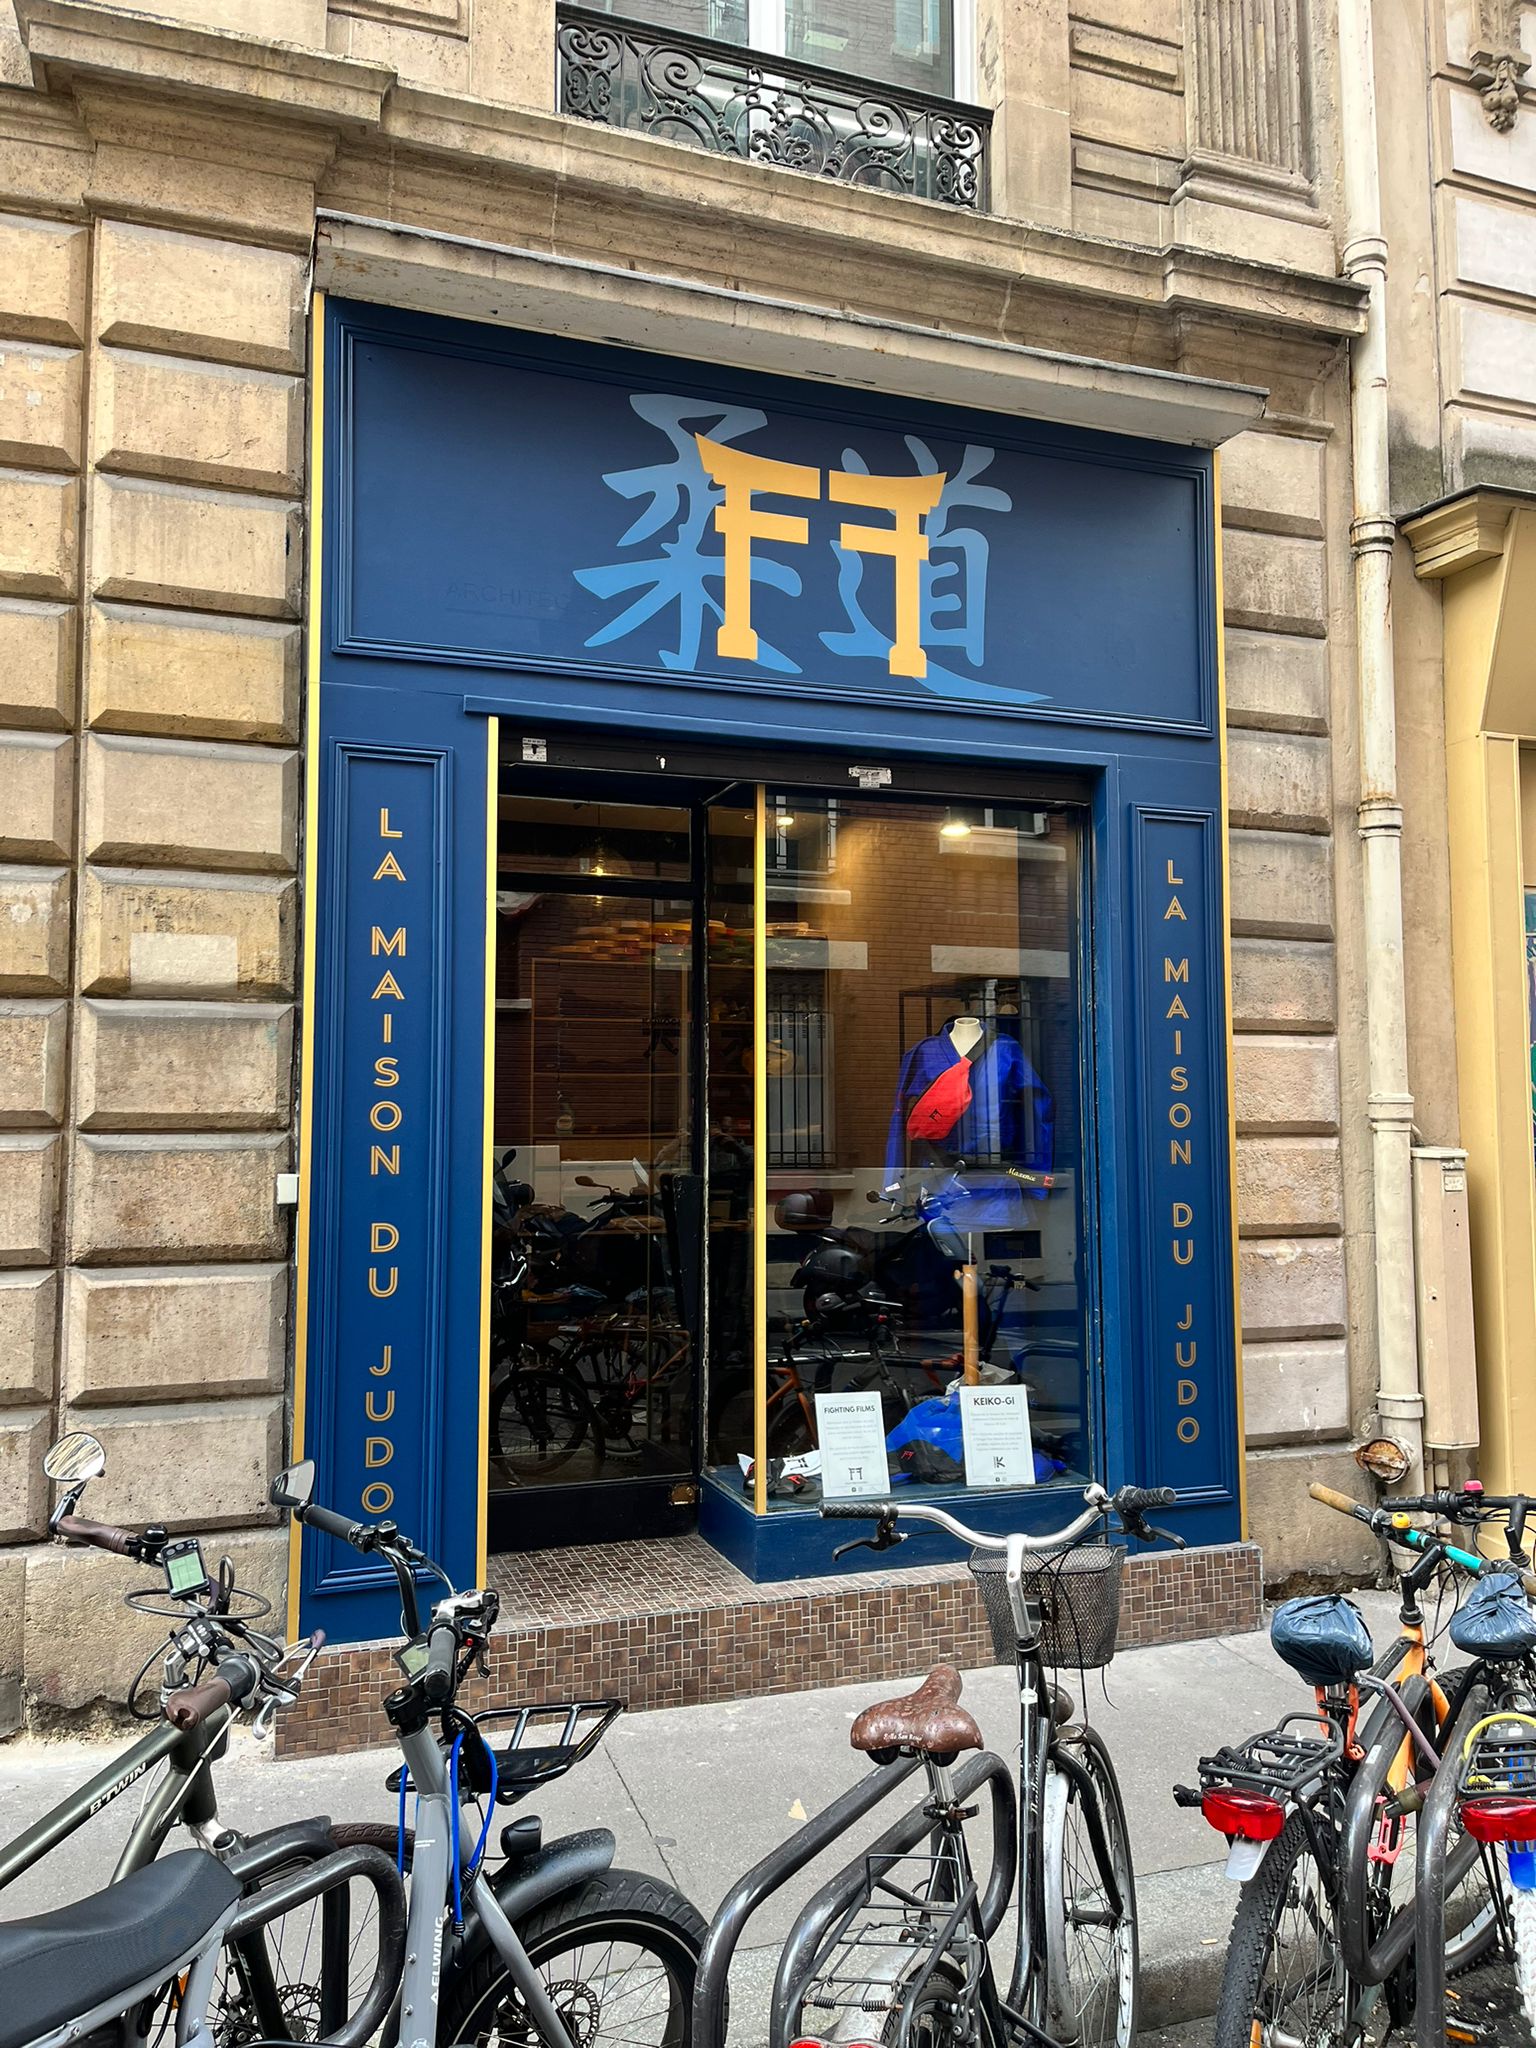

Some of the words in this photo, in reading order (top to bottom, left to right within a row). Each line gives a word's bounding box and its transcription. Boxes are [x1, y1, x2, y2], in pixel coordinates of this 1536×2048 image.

[372, 807, 406, 882] LA
[1163, 859, 1188, 921] LA
[369, 926, 407, 1176] MAISON
[1163, 957, 1193, 1165] MAISON
[368, 1222, 400, 1298] DU
[1172, 1202, 1195, 1265] DU
[824, 1406, 855, 1414] FIGHTING
[856, 1405, 876, 1413] FILMS
[973, 1396, 1015, 1406] KEIKO-GI
[1176, 1304, 1200, 1443] JUDO
[361, 1345, 395, 1514] JUDO
